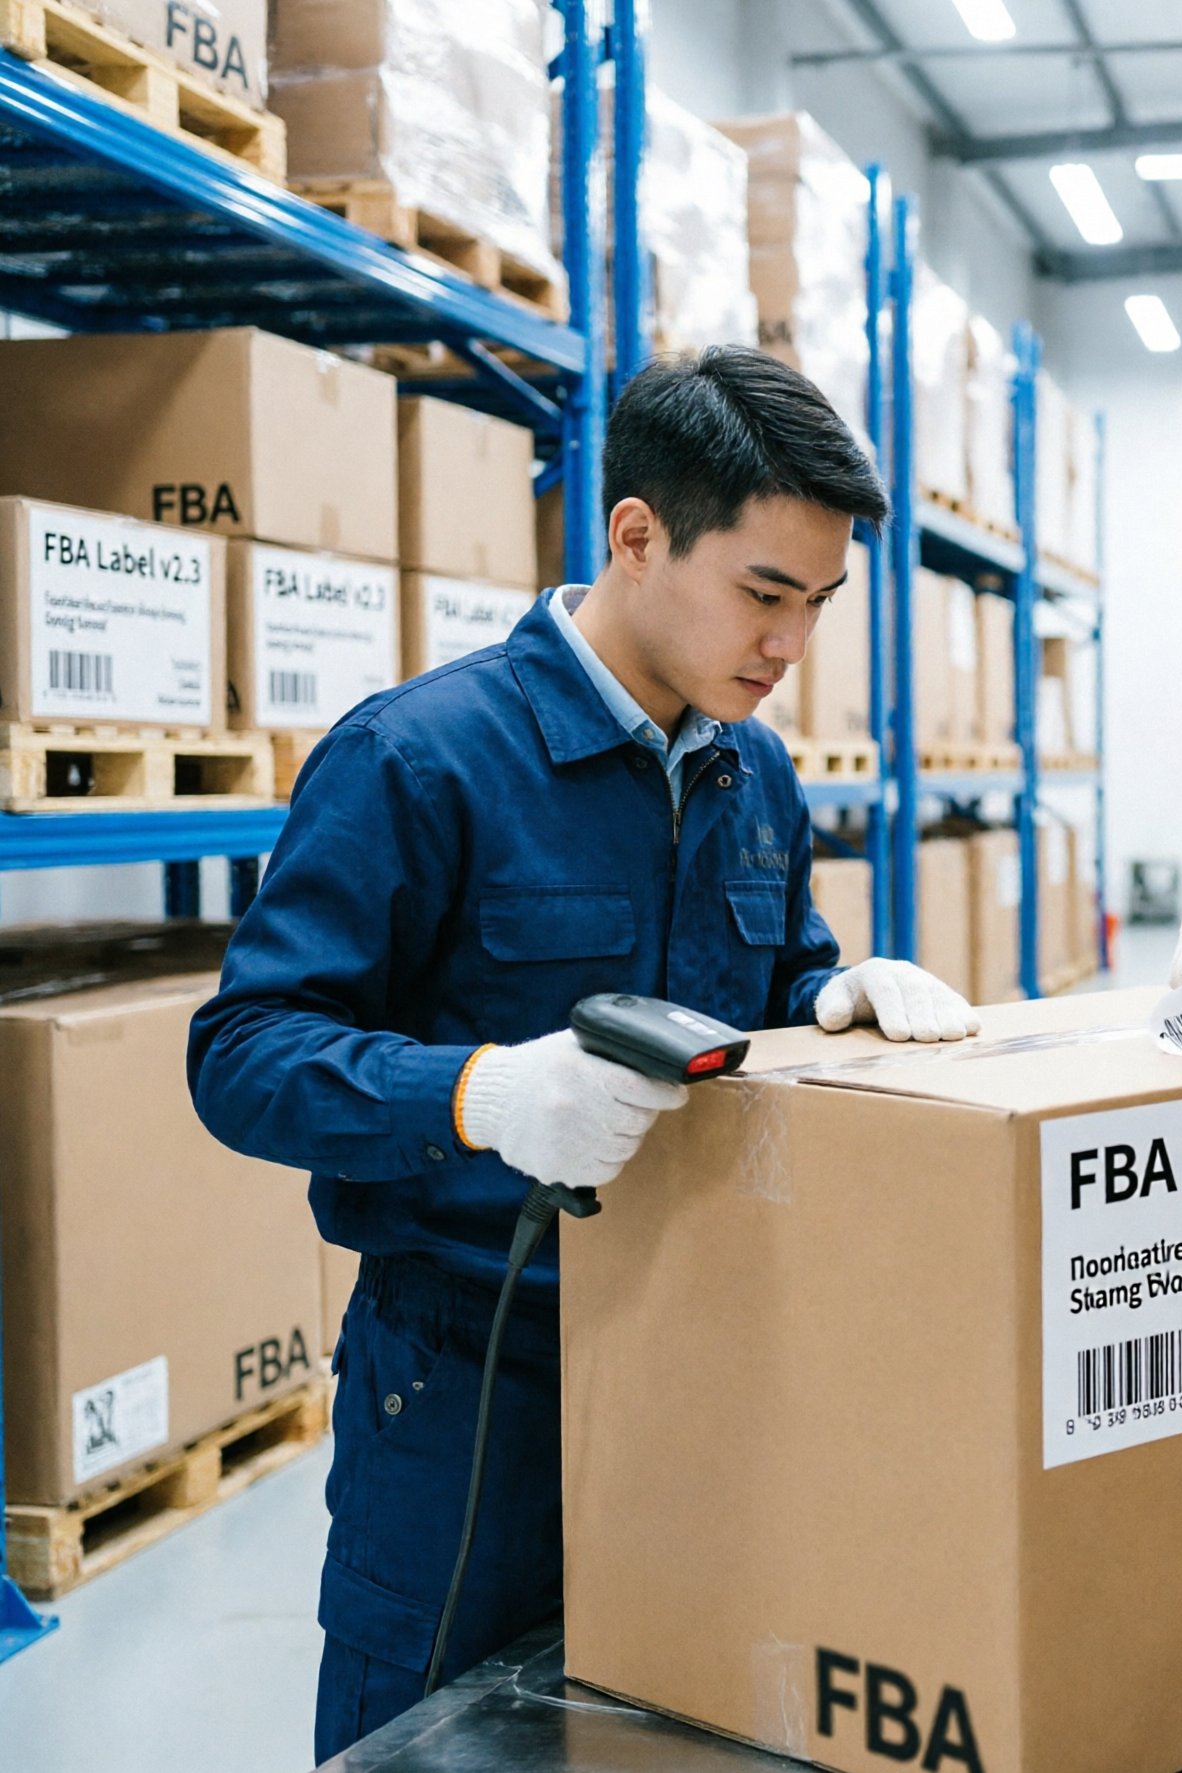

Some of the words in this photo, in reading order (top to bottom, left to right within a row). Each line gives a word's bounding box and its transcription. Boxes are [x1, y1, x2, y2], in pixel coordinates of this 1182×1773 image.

[166, 0, 249, 89] FBA
[152, 483, 241, 526] FBA
[45, 532, 90, 568] FBA
[97, 541, 155, 578] Label
[161, 555, 201, 585] v2.3
[264, 567, 299, 597] FBA
[1071, 1137, 1178, 1211] FBA
[235, 1327, 310, 1402] FBA
[814, 1644, 985, 1773] FBA
